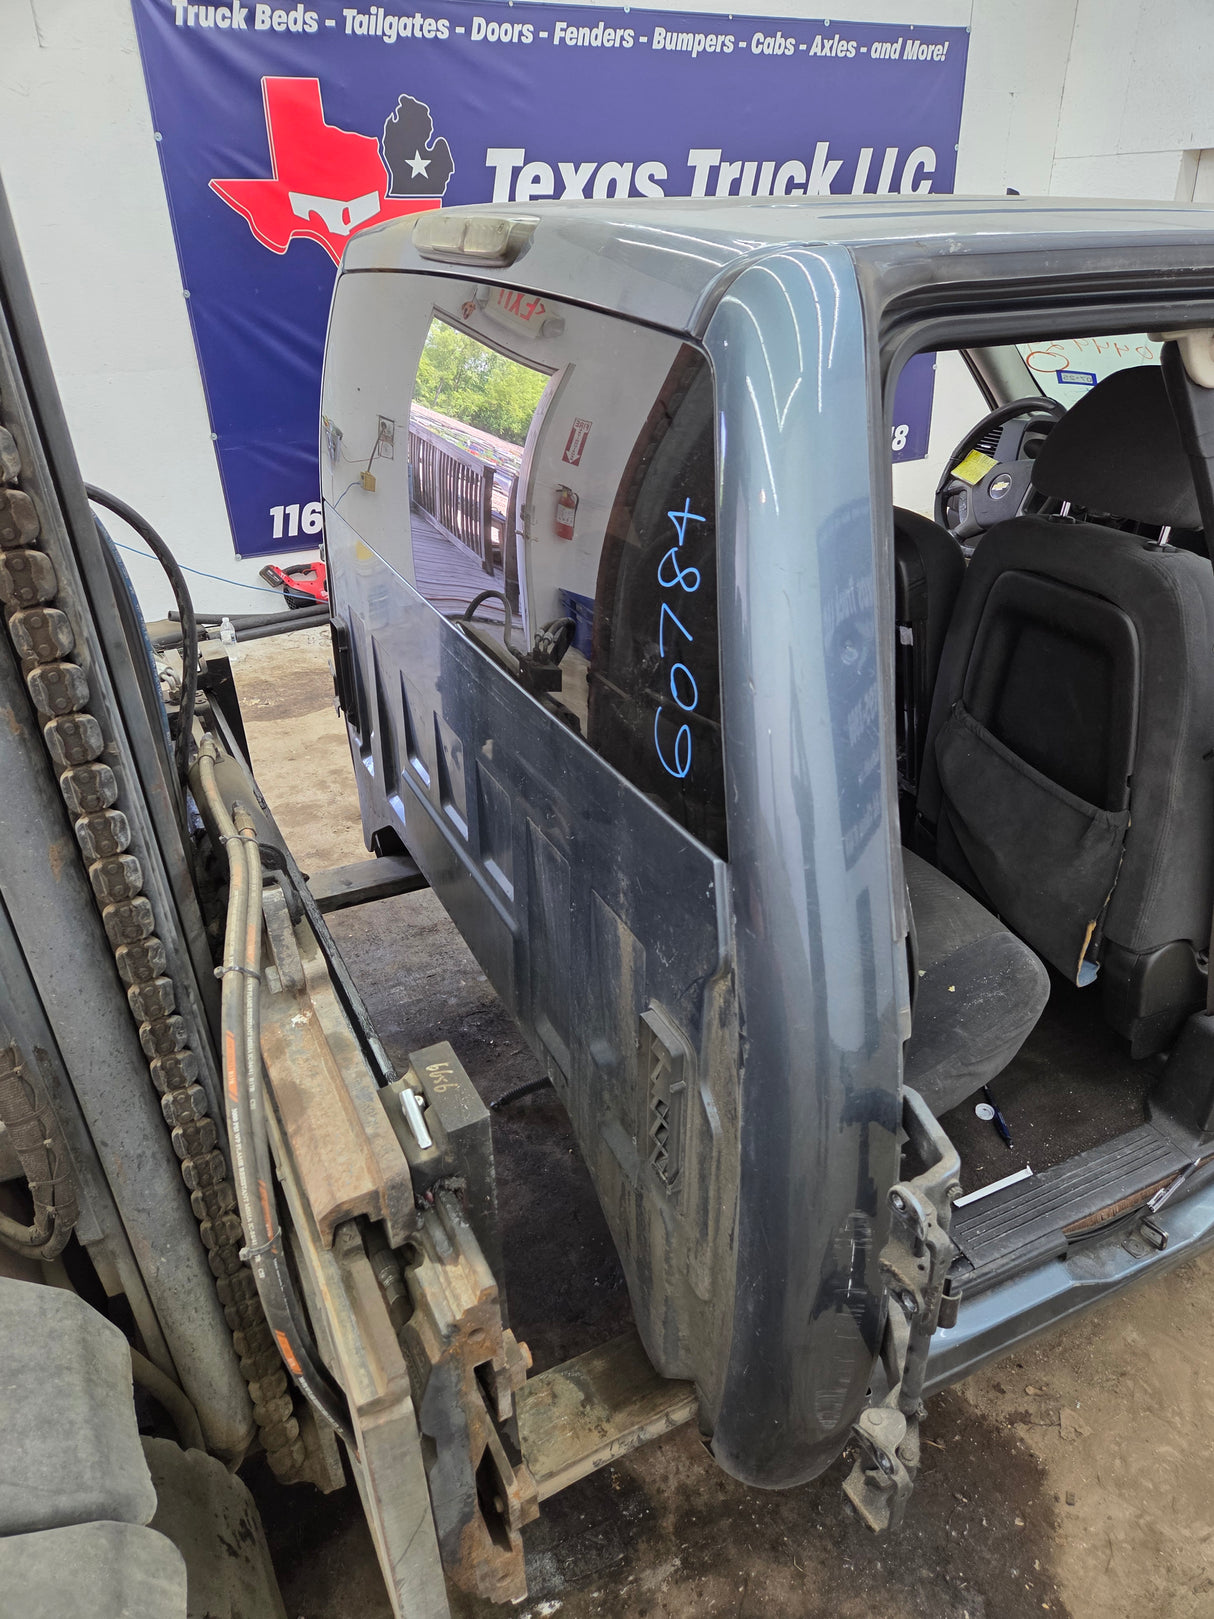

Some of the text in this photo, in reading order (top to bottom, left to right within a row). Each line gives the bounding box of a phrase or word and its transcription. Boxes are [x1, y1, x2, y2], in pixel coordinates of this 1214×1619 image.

[171, 0, 248, 31] Truck
[254, 4, 318, 33] Beds
[343, 7, 450, 44] Tailgates
[471, 16, 534, 43] Doors
[553, 21, 634, 49] Fenders
[652, 27, 735, 58] Bumpers
[751, 32, 795, 56] Cabs
[809, 34, 856, 58] Axles
[870, 38, 902, 60] and
[903, 39, 949, 62] More!
[486, 148, 668, 202] Texas
[687, 142, 845, 198] Truck
[269, 501, 322, 538] 116
[654, 497, 706, 778] 60784
